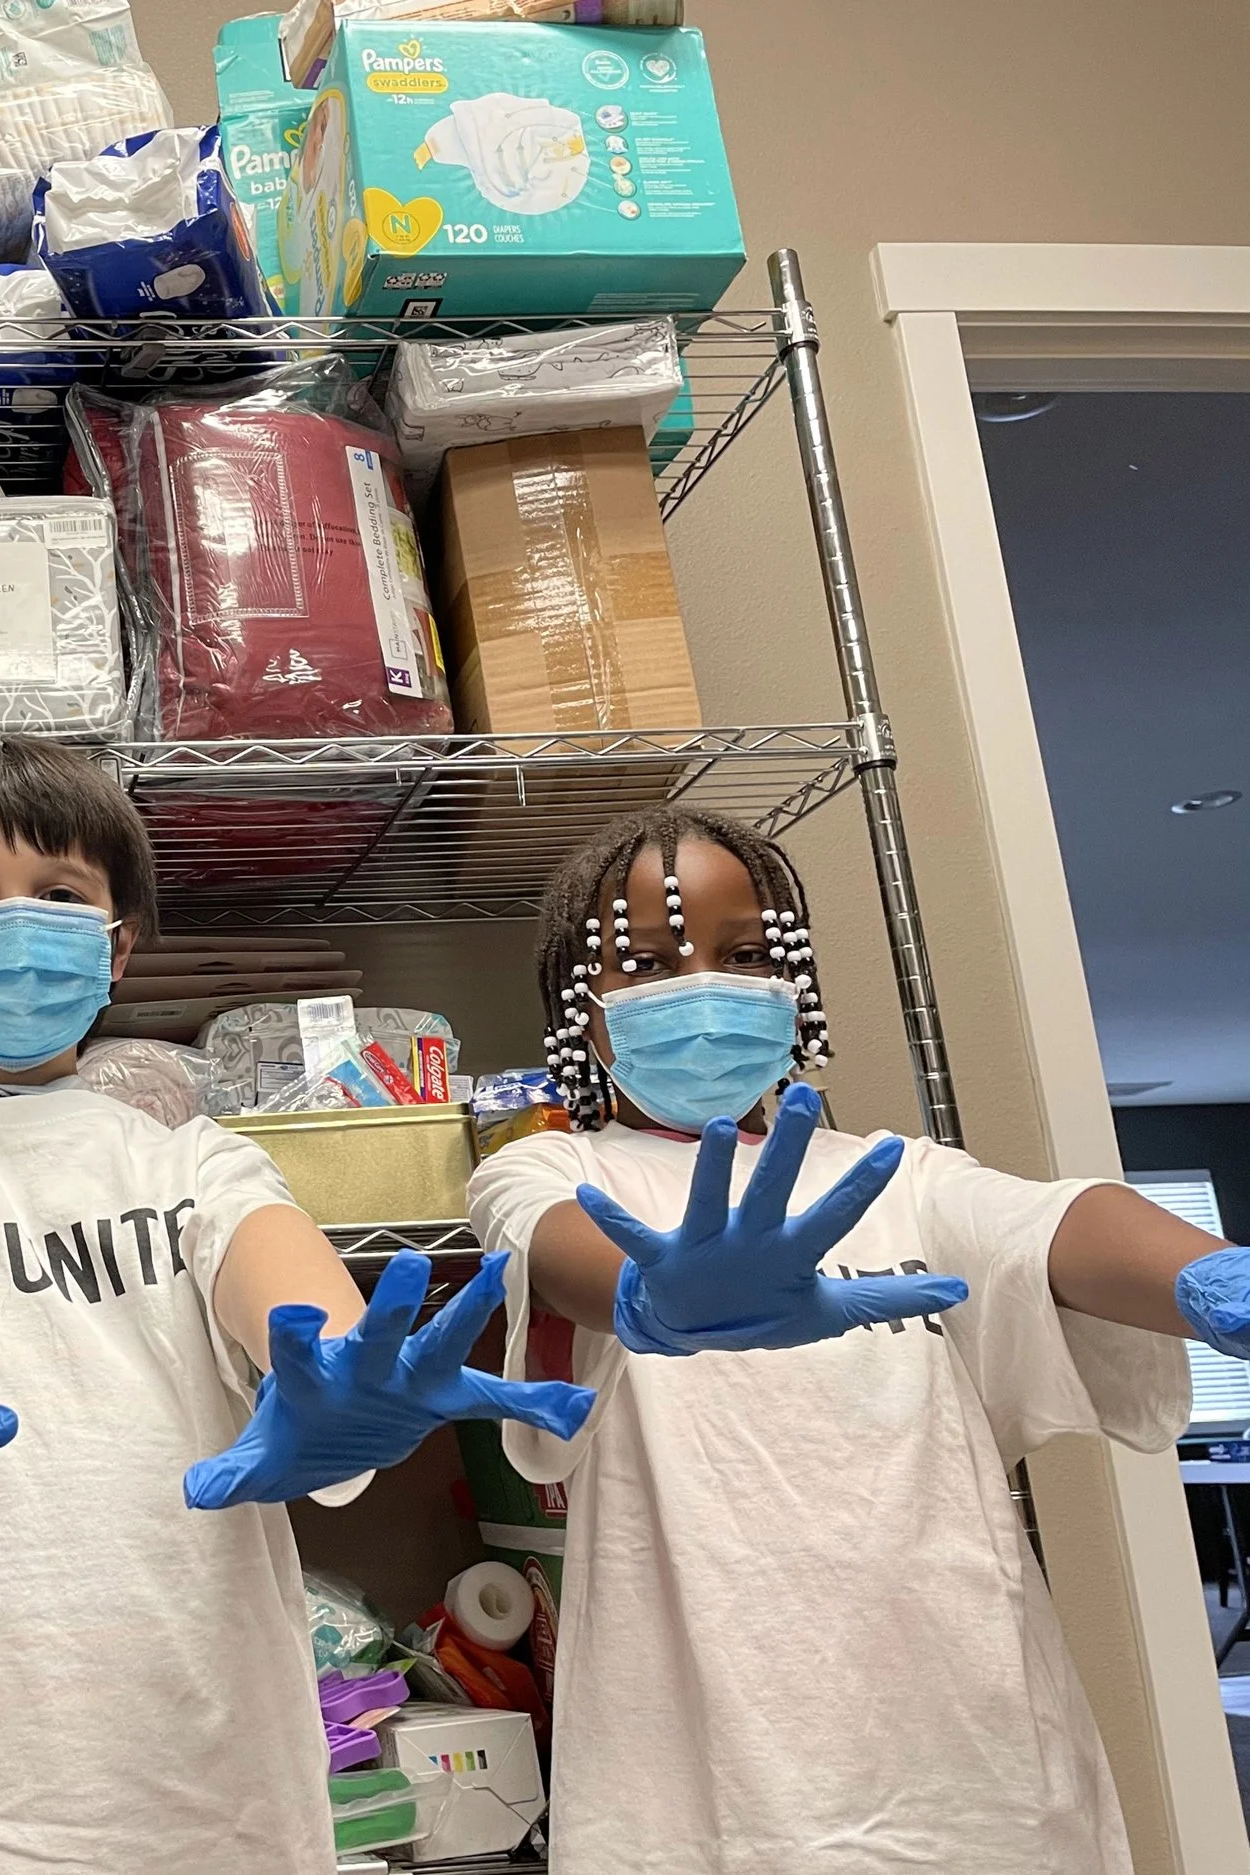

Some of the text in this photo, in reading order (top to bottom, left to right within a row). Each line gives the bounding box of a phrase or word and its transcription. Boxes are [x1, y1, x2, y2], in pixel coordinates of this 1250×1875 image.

[362, 49, 444, 75] Pampers
[373, 78, 444, 87] swaddlers
[390, 213, 412, 234] N
[443, 224, 521, 244] 120 DIAPERS
[494, 234, 525, 243] COUCHES
[354, 452, 365, 462] 8
[364, 482, 373, 500] Set
[366, 502, 382, 549] Bedding
[375, 550, 391, 601] Complete
[390, 669, 403, 685] K
[429, 1045, 443, 1100] Colgate
